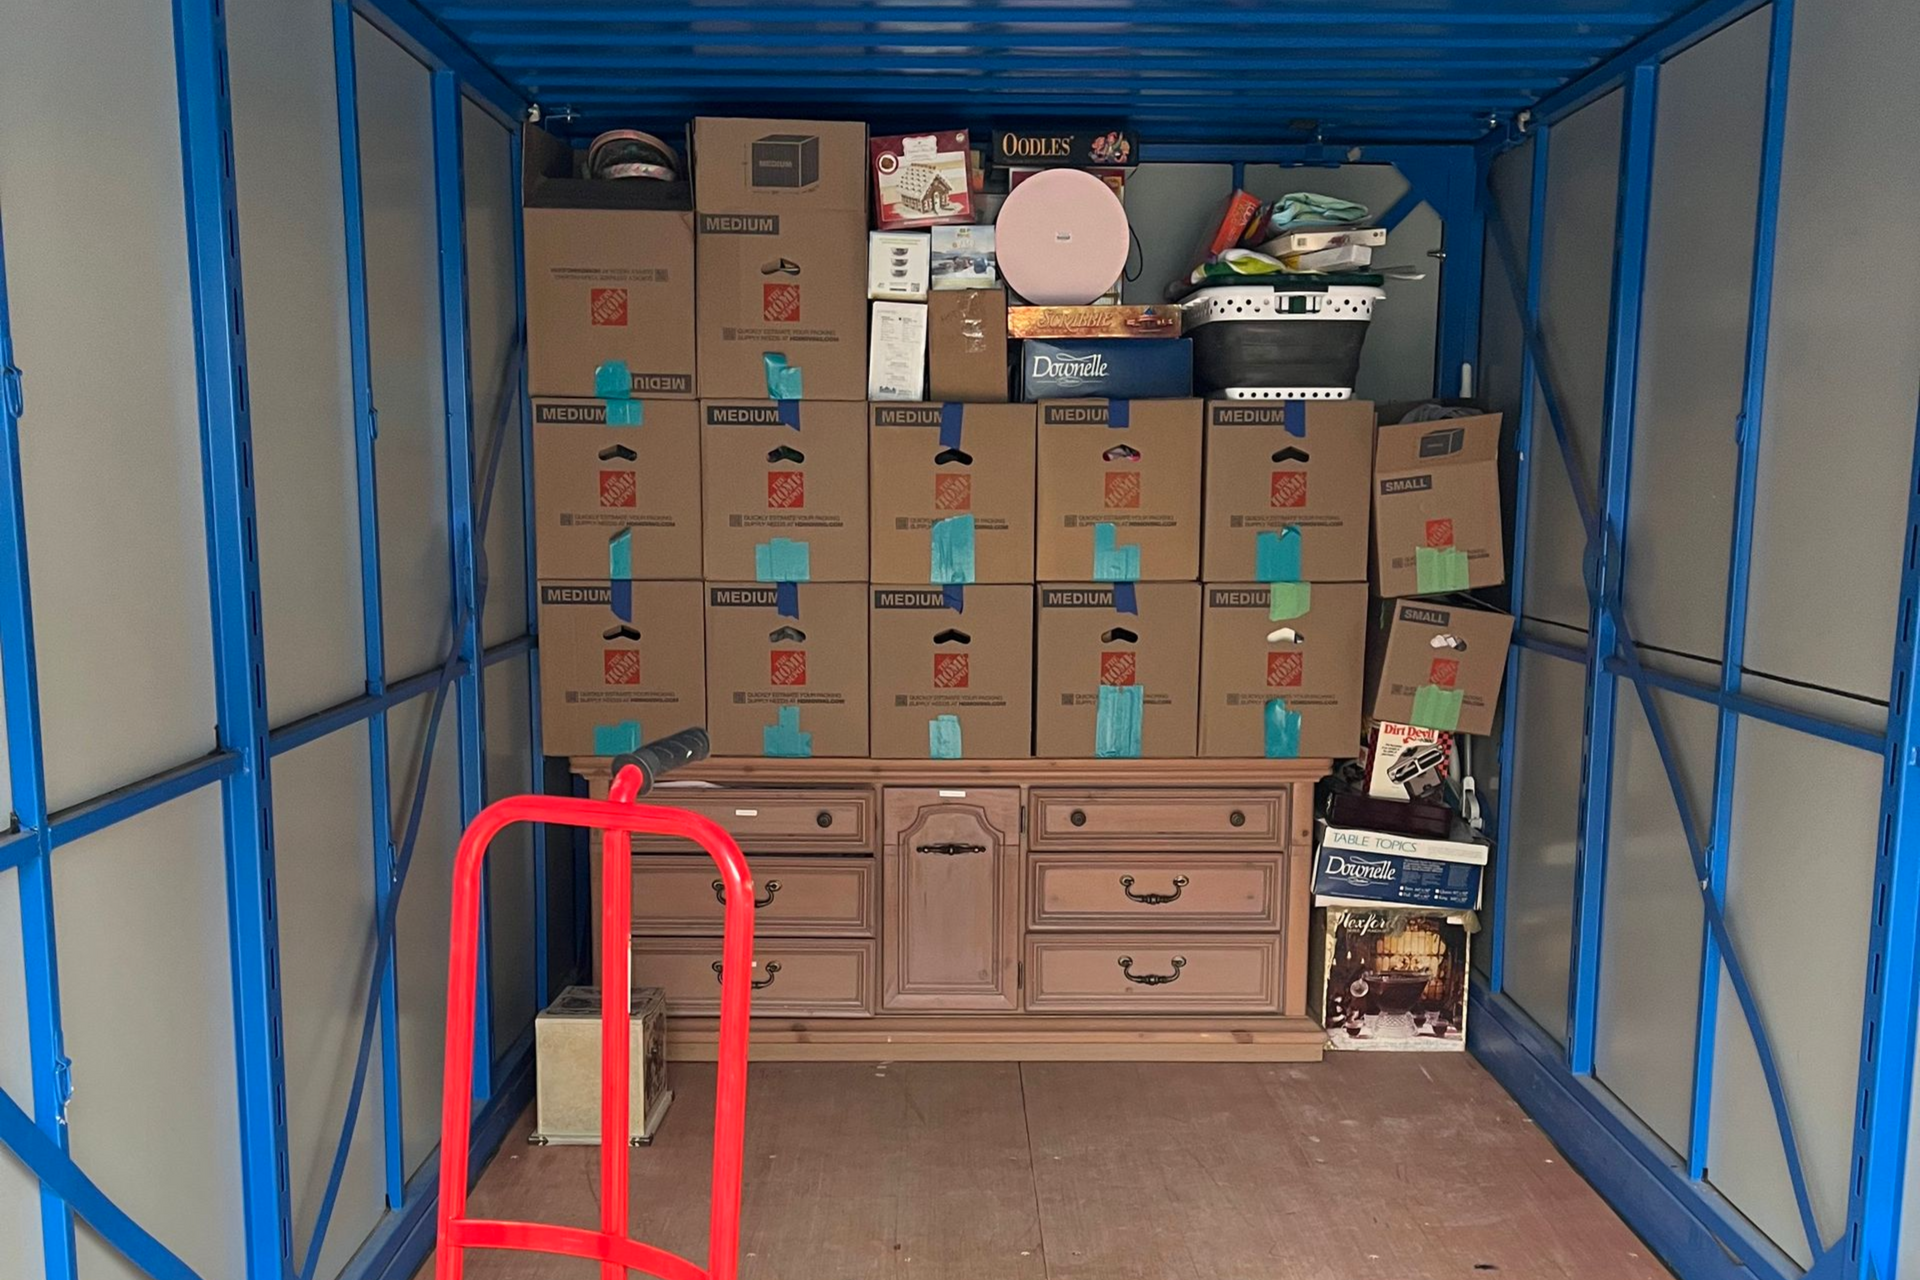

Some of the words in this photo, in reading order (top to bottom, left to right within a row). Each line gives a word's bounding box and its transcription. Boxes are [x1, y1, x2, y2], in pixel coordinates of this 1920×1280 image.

[1002, 132, 1070, 156] OODLES
[707, 218, 772, 231] MEDIUM
[764, 286, 800, 320] HOME
[1032, 353, 1110, 377] Downelle
[634, 378, 685, 390] MEDIU
[543, 408, 606, 420] MEDIUM
[714, 410, 779, 422] MEDIUM
[1220, 410, 1284, 422] MEDIUM
[600, 473, 636, 507] HOME
[768, 473, 803, 507] HOME
[1272, 473, 1306, 506] HOME
[1385, 478, 1427, 492] SMALL
[717, 591, 778, 603] MEDIUM
[881, 594, 944, 606] MEDIUM
[1049, 592, 1112, 604] MEDIUM
[1216, 593, 1271, 604] MEDIU
[1404, 609, 1444, 624] SMALL
[605, 652, 640, 684] HOME
[771, 652, 805, 684] HOME
[934, 655, 968, 687] HOME
[1268, 654, 1302, 686] HOME
[1384, 724, 1406, 735] Dirt
[1407, 726, 1435, 738] Devil
[1333, 832, 1369, 846] TABLE
[1375, 837, 1417, 853] TOPICS
[1325, 854, 1396, 880] Downelle
